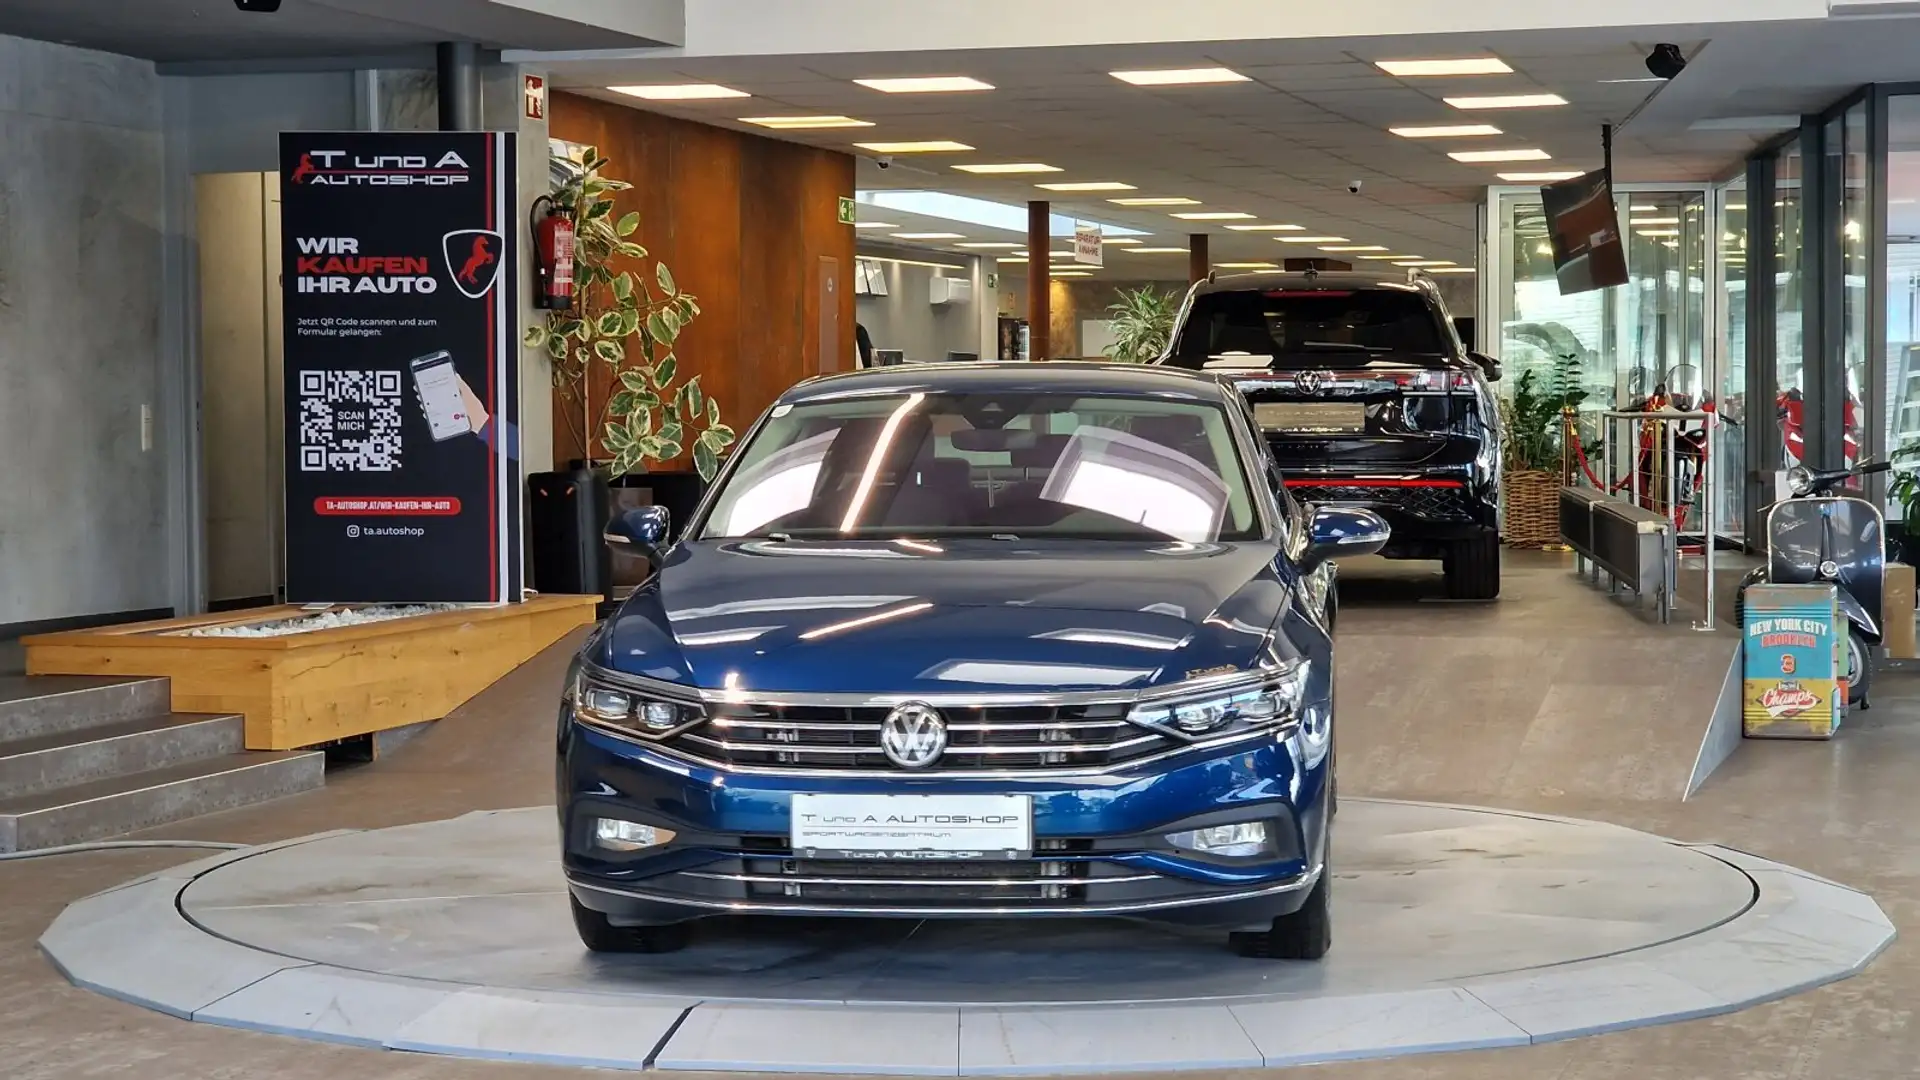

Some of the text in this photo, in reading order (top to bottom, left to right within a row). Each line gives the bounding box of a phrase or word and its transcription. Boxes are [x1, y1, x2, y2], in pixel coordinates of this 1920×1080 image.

[310, 150, 346, 168] T
[434, 150, 470, 168] A
[310, 174, 469, 185] AUTOSHOP
[297, 237, 358, 254] WIR
[298, 256, 428, 274] KAUFEN
[298, 276, 437, 293] IHR AUTO
[297, 317, 318, 326] Jetzt
[320, 317, 334, 327] QR
[336, 317, 358, 326] Code
[398, 318, 416, 326] und
[297, 327, 383, 338] Formular gelangen:
[337, 411, 365, 420] SCAN
[337, 421, 365, 431] MICH
[326, 501, 450, 510] TA-AUTOSHOP.AT/WIR-KAUFEN-IHR-AUTO
[363, 526, 424, 537] ta.autoshop
[1750, 618, 1828, 637] NEW YORK CITY
[1762, 688, 1813, 709] Champs
[801, 814, 817, 823] T
[863, 815, 878, 823] A
[886, 815, 1019, 824] AUTOSHOP
[892, 850, 984, 860] AUTOSHOP
